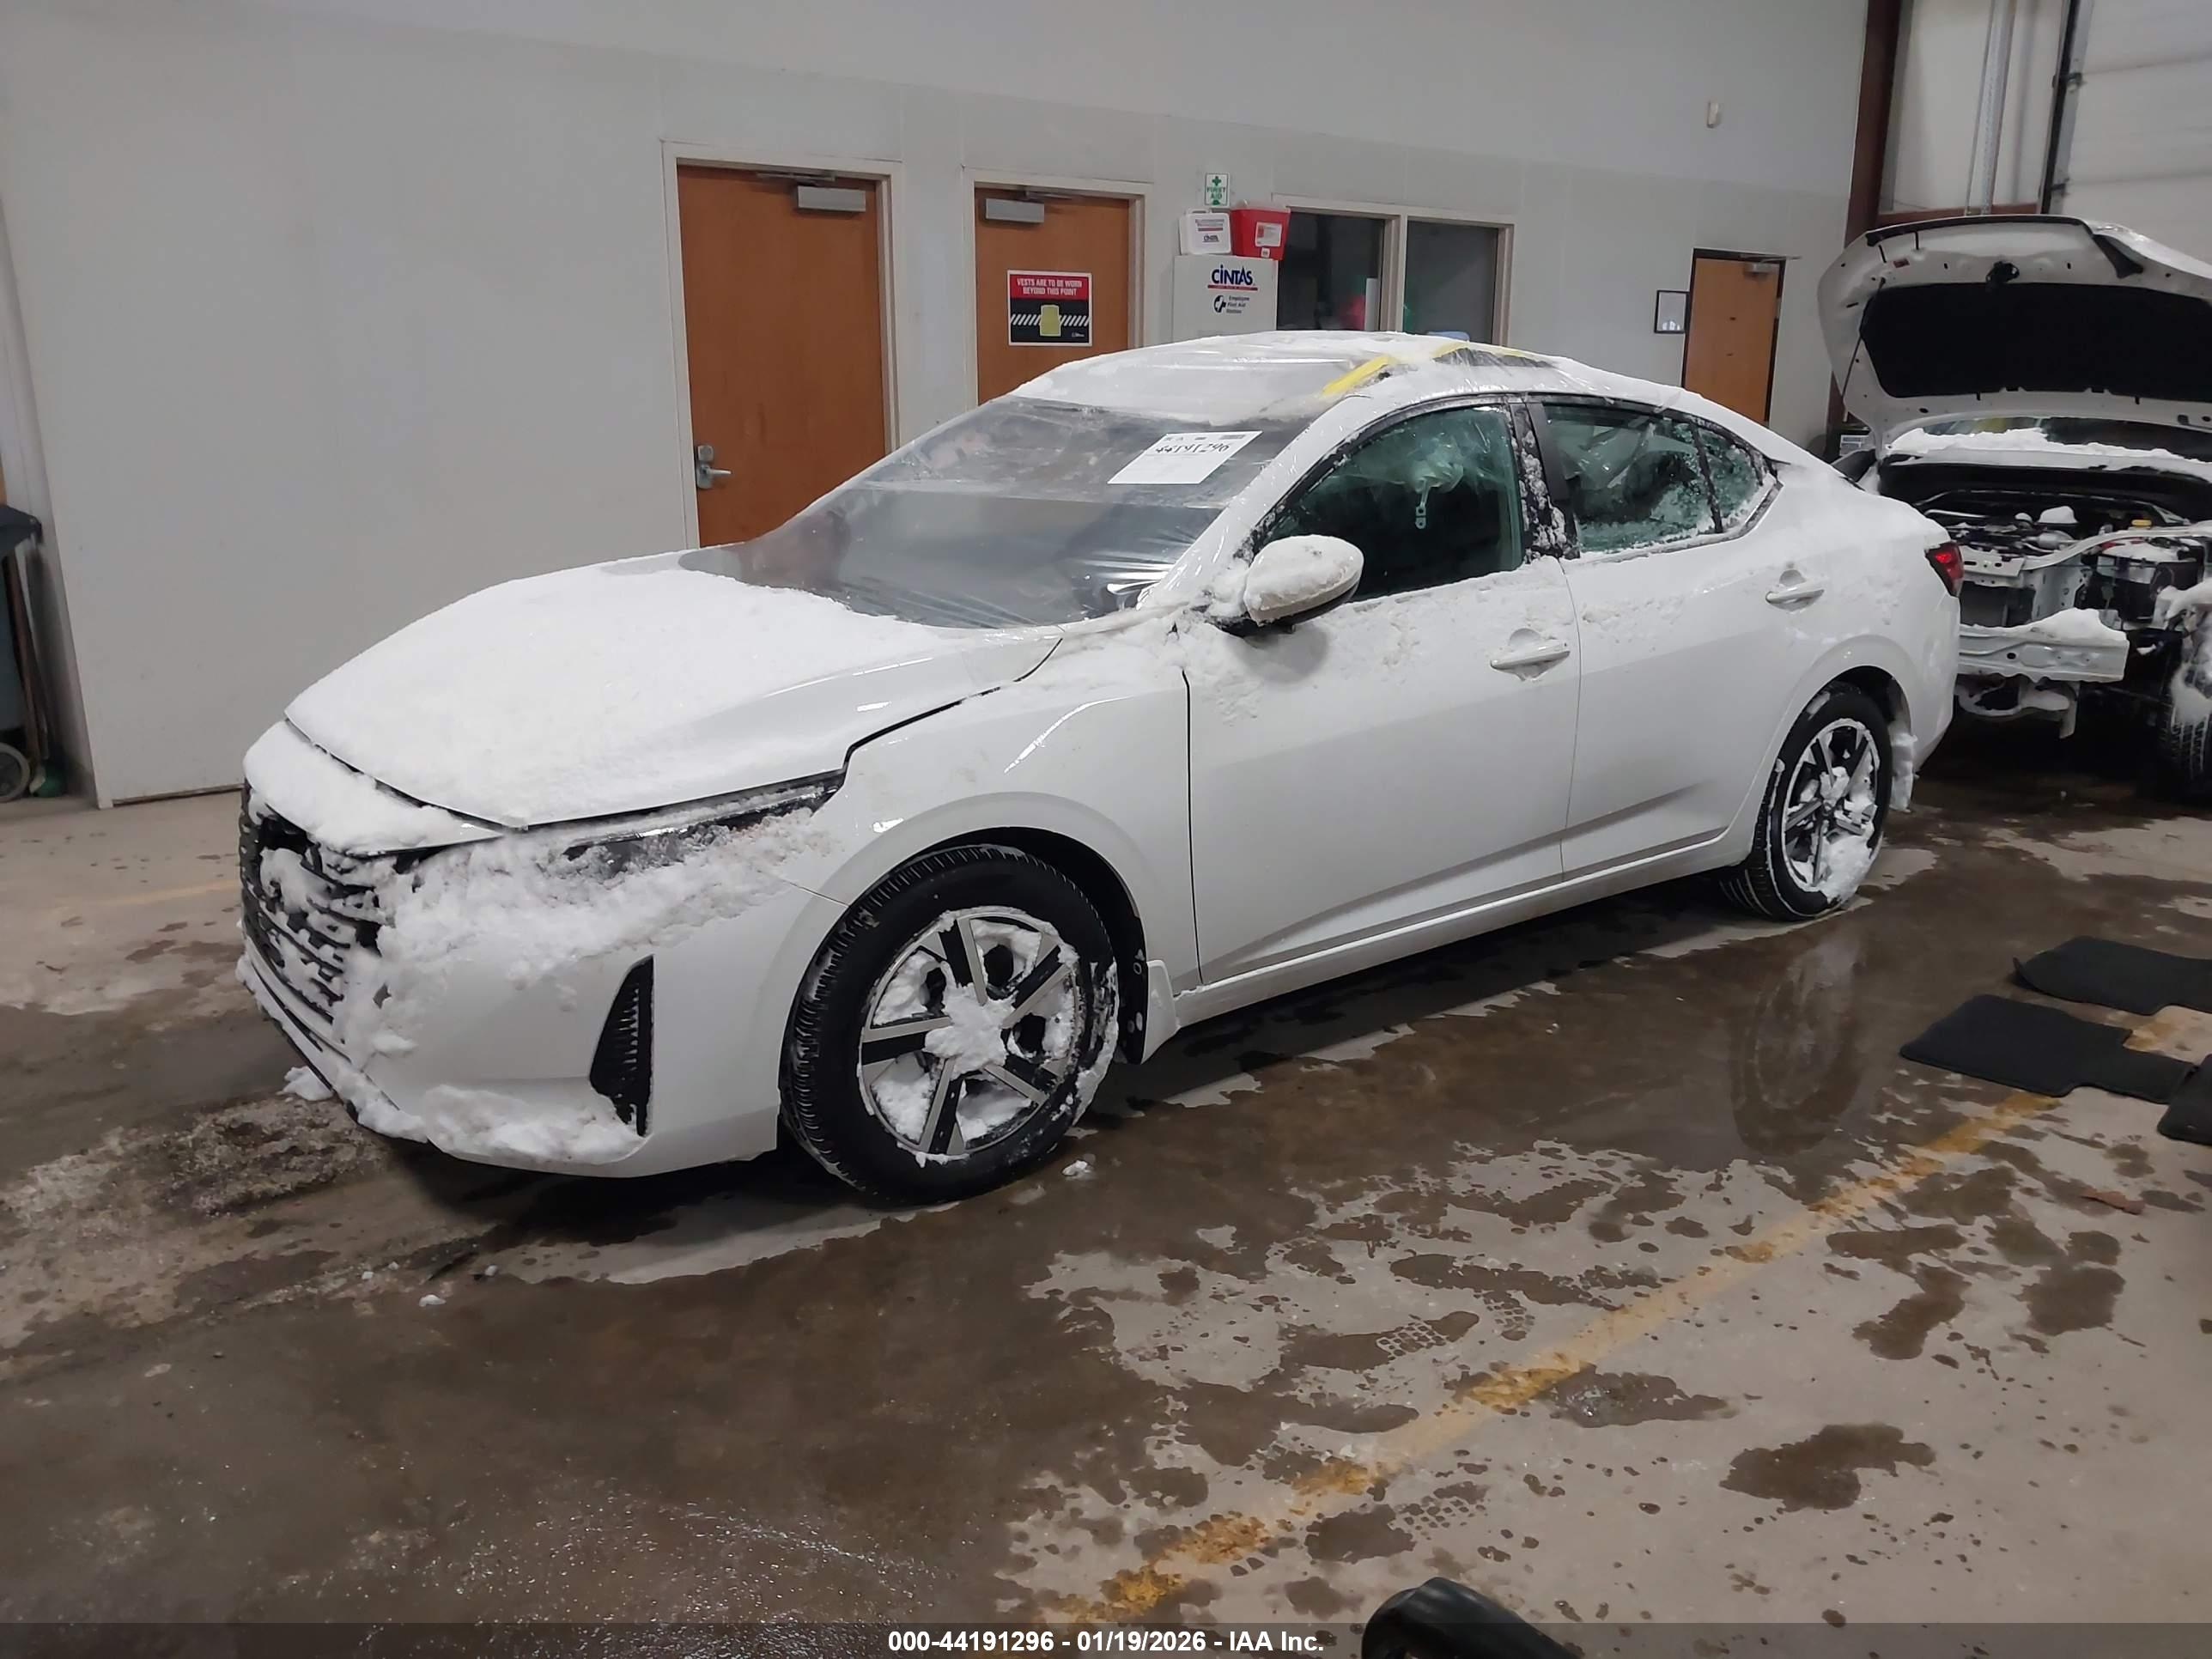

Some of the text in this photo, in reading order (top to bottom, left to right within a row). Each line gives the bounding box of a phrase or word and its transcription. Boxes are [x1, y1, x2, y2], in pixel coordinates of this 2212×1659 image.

[1017, 277, 1035, 286] VESTS
[1036, 278, 1047, 287] ARE
[1023, 286, 1045, 295] BEYOND
[1047, 287, 1059, 295] THIS
